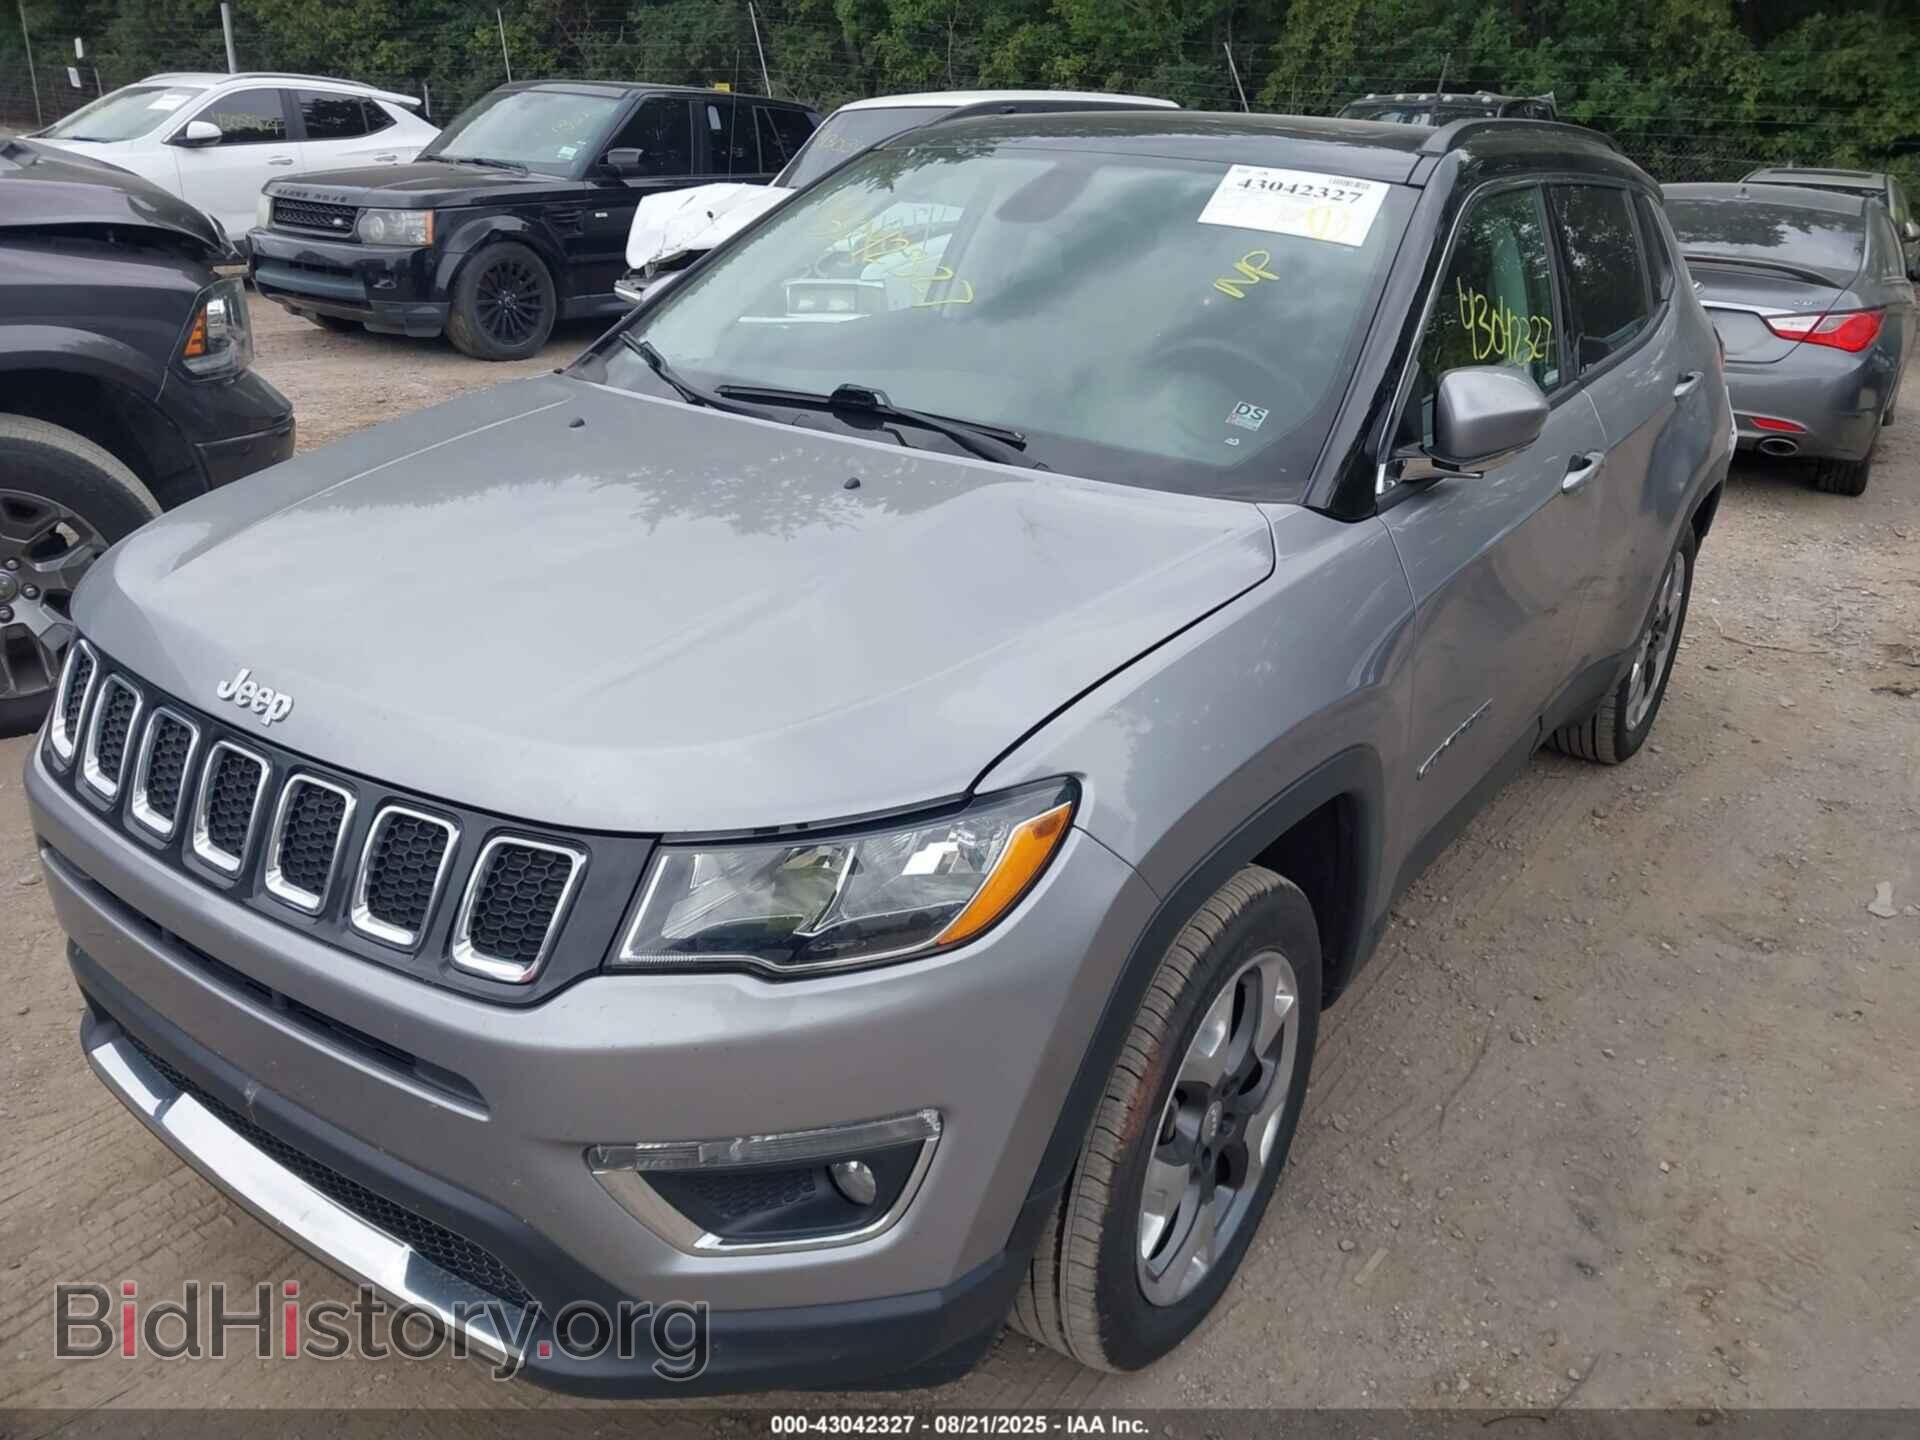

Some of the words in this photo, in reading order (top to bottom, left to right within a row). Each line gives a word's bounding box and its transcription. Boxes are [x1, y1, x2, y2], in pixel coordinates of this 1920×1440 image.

[1237, 178, 1364, 204] 43042327
[1456, 276, 1552, 367] 43042327
[1236, 403, 1265, 420] DS
[216, 667, 294, 728] Jeep
